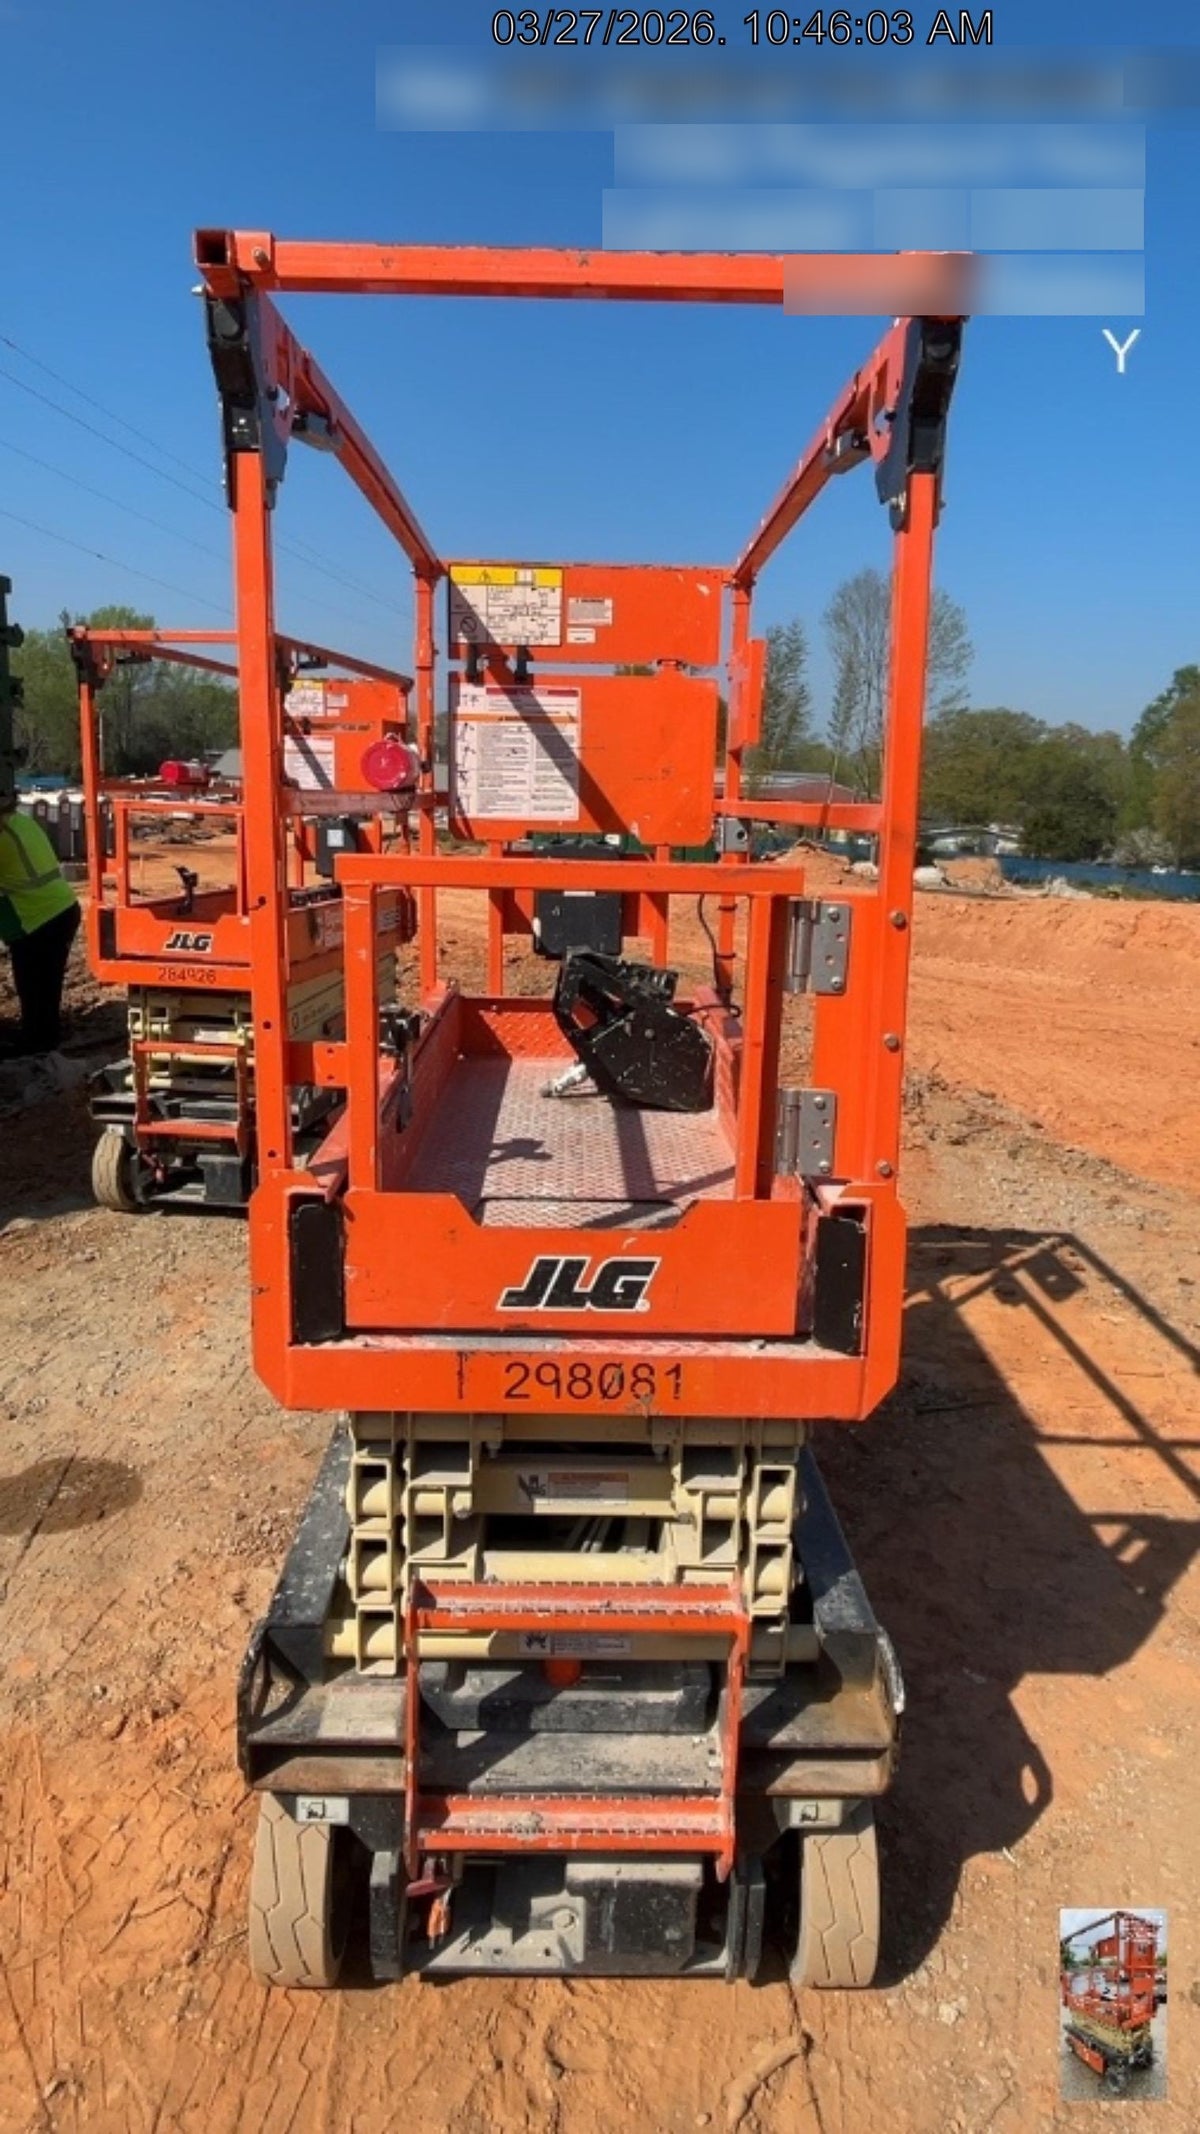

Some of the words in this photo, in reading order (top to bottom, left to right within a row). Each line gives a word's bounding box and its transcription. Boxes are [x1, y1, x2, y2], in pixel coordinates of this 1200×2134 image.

[164, 932, 212, 952] JLG
[496, 1256, 661, 1311] JLG
[504, 1361, 682, 1401] 298081
